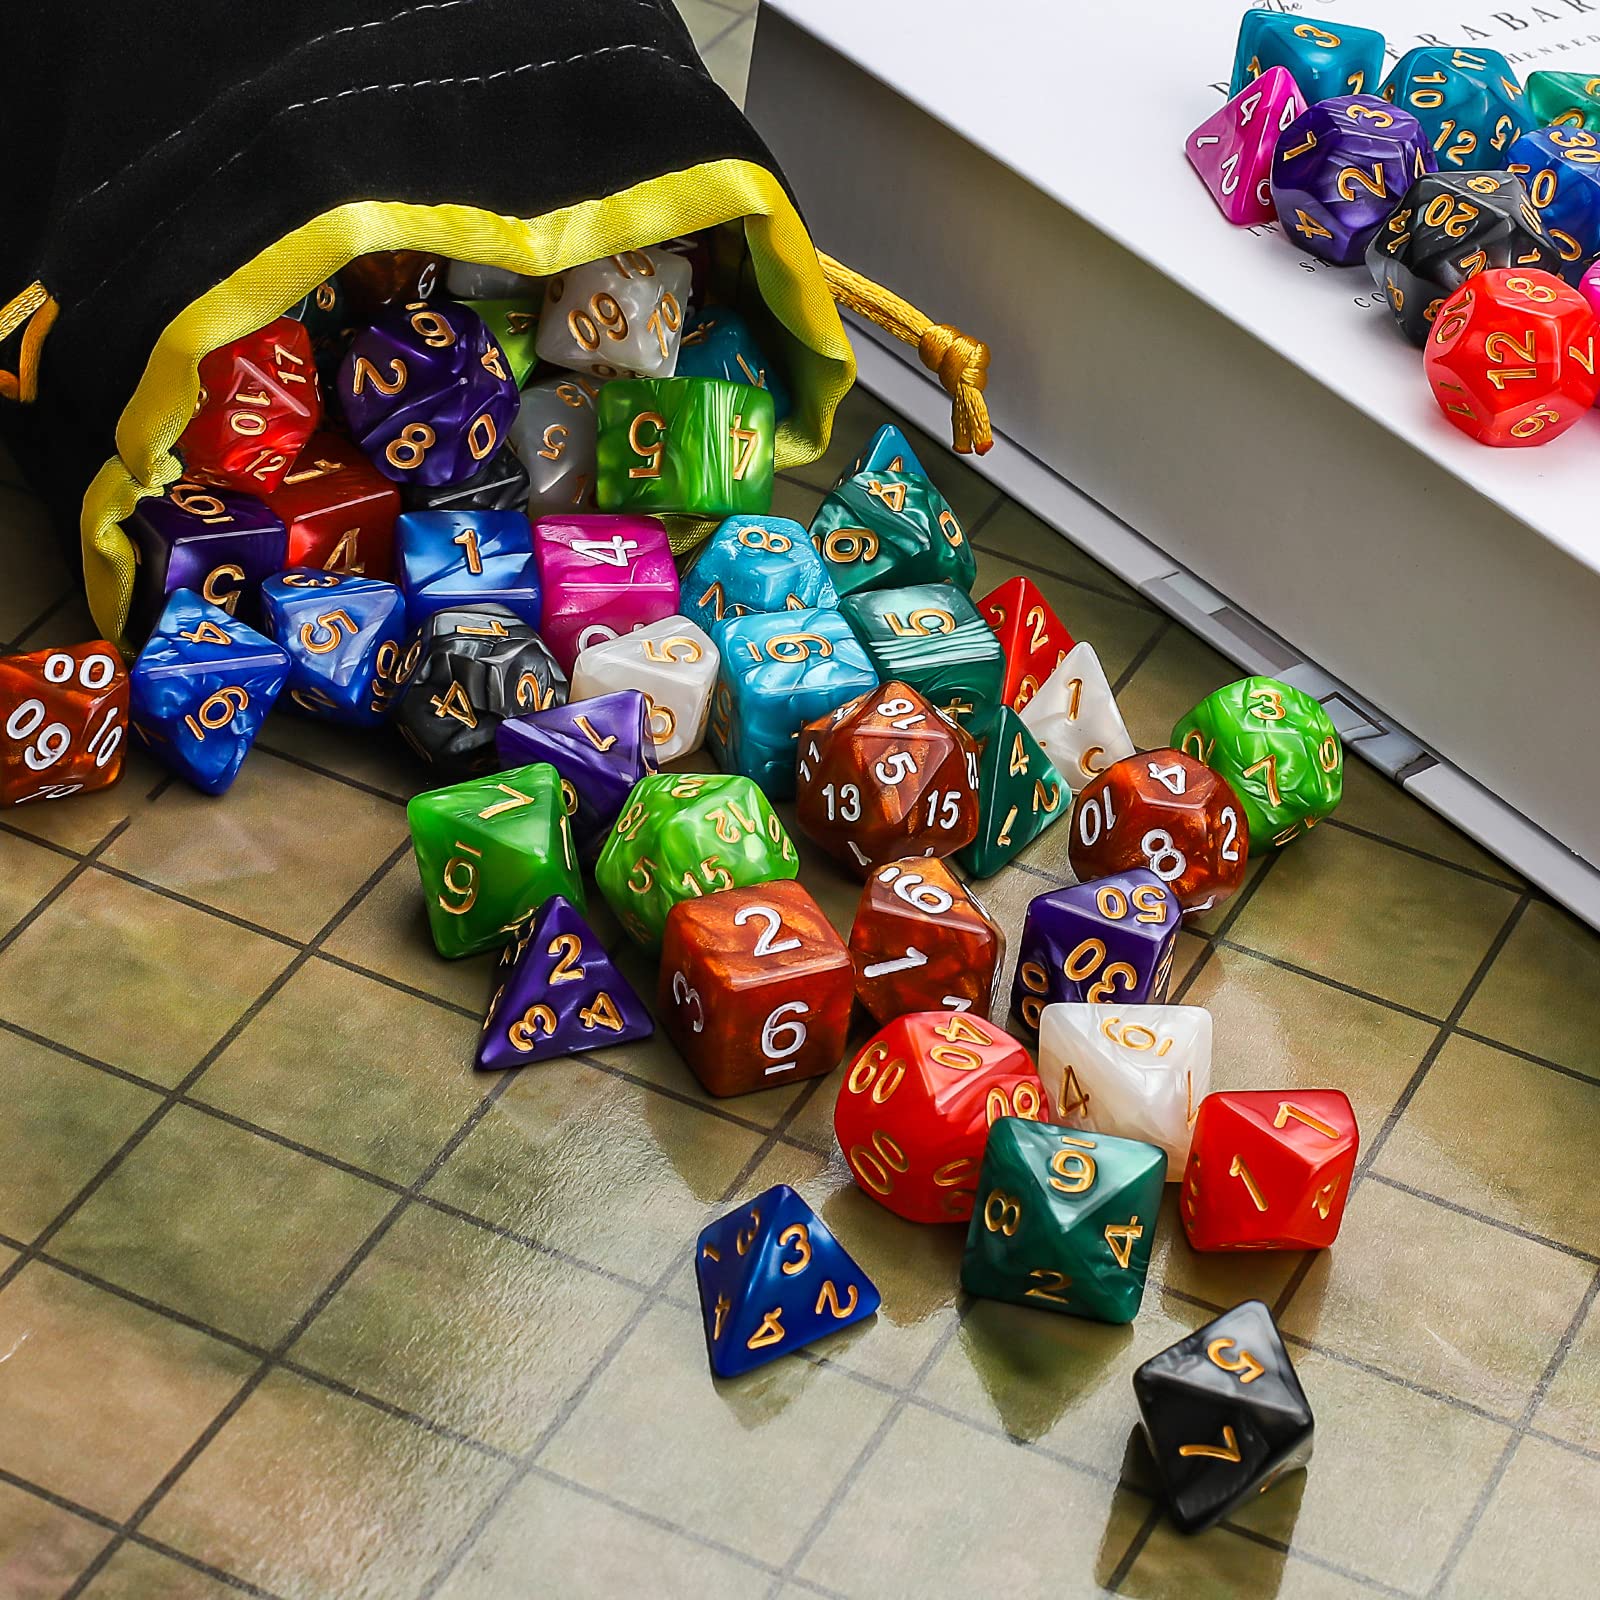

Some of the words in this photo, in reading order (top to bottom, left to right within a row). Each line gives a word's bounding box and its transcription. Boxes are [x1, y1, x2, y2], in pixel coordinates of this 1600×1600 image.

[1293, 24, 1341, 48] 3
[1240, 92, 1262, 127] 4
[1410, 71, 1447, 109] 10
[1346, 104, 1393, 128] 3
[1197, 136, 1219, 147] 1
[1413, 119, 1477, 166] 12
[1221, 154, 1239, 195] 2
[1337, 162, 1386, 201] 2
[1295, 208, 1333, 239] 4
[1425, 193, 1478, 237] 20
[1506, 277, 1557, 302] 8
[1436, 289, 1475, 344] 10
[274, 344, 306, 384] 17
[1485, 330, 1536, 389] 12
[1568, 336, 1594, 374] 7
[354, 357, 408, 396] 2
[230, 391, 271, 436] 10
[385, 423, 436, 470] 8
[468, 414, 497, 460] 0
[537, 423, 569, 461] 5
[629, 411, 667, 479] 5
[729, 414, 758, 481] 4
[244, 449, 286, 482] 12
[868, 480, 906, 512] 4
[737, 527, 792, 553] 8
[938, 511, 963, 547] 0
[453, 528, 482, 575] 1
[570, 535, 638, 567] 4
[203, 564, 246, 616] 5
[180, 621, 232, 646] 4
[301, 609, 358, 654] 5
[456, 620, 509, 637] 1
[884, 608, 956, 637] 5
[1026, 605, 1049, 654] 2
[643, 636, 703, 664] 5
[43, 654, 115, 690] 00
[516, 672, 554, 712] 2
[430, 680, 478, 729] 4
[877, 698, 926, 730] 18
[1066, 678, 1083, 720] 1
[1249, 691, 1287, 721] 3
[88, 707, 123, 768] 10
[1009, 732, 1030, 778] 4
[799, 740, 820, 783] 11
[875, 752, 918, 785] 5
[1148, 762, 1187, 795] 4
[478, 783, 535, 820] 7
[822, 784, 861, 822] 13
[927, 790, 962, 830] 15
[1032, 779, 1059, 813] 2
[1079, 786, 1117, 847] 10
[617, 802, 650, 841] 18
[705, 801, 755, 843] 12
[768, 815, 790, 860] 10
[997, 805, 1019, 848] 1
[1220, 806, 1239, 862] 2
[628, 856, 658, 893] 5
[1141, 828, 1187, 882] 8
[682, 856, 734, 896] 15
[1096, 885, 1168, 924] 50
[734, 906, 802, 957] 2
[548, 933, 585, 985] 2
[1064, 938, 1138, 1004] 30
[579, 991, 625, 1032] 4
[673, 970, 704, 1033] 3
[508, 1004, 558, 1052] 3
[761, 1001, 809, 1077] 6
[930, 1016, 993, 1071] 40
[848, 1040, 907, 1104] 60
[1058, 1065, 1090, 1118] 4
[850, 1130, 910, 1196] 00
[1229, 1153, 1269, 1212] 1
[984, 1188, 1021, 1237] 8
[779, 1223, 813, 1275] 3
[1104, 1215, 1144, 1269] 4
[815, 1279, 859, 1319] 2
[1024, 1268, 1073, 1304] 2
[747, 1306, 786, 1350] 4
[1207, 1338, 1266, 1384] 5
[1178, 1425, 1242, 1462] 7
